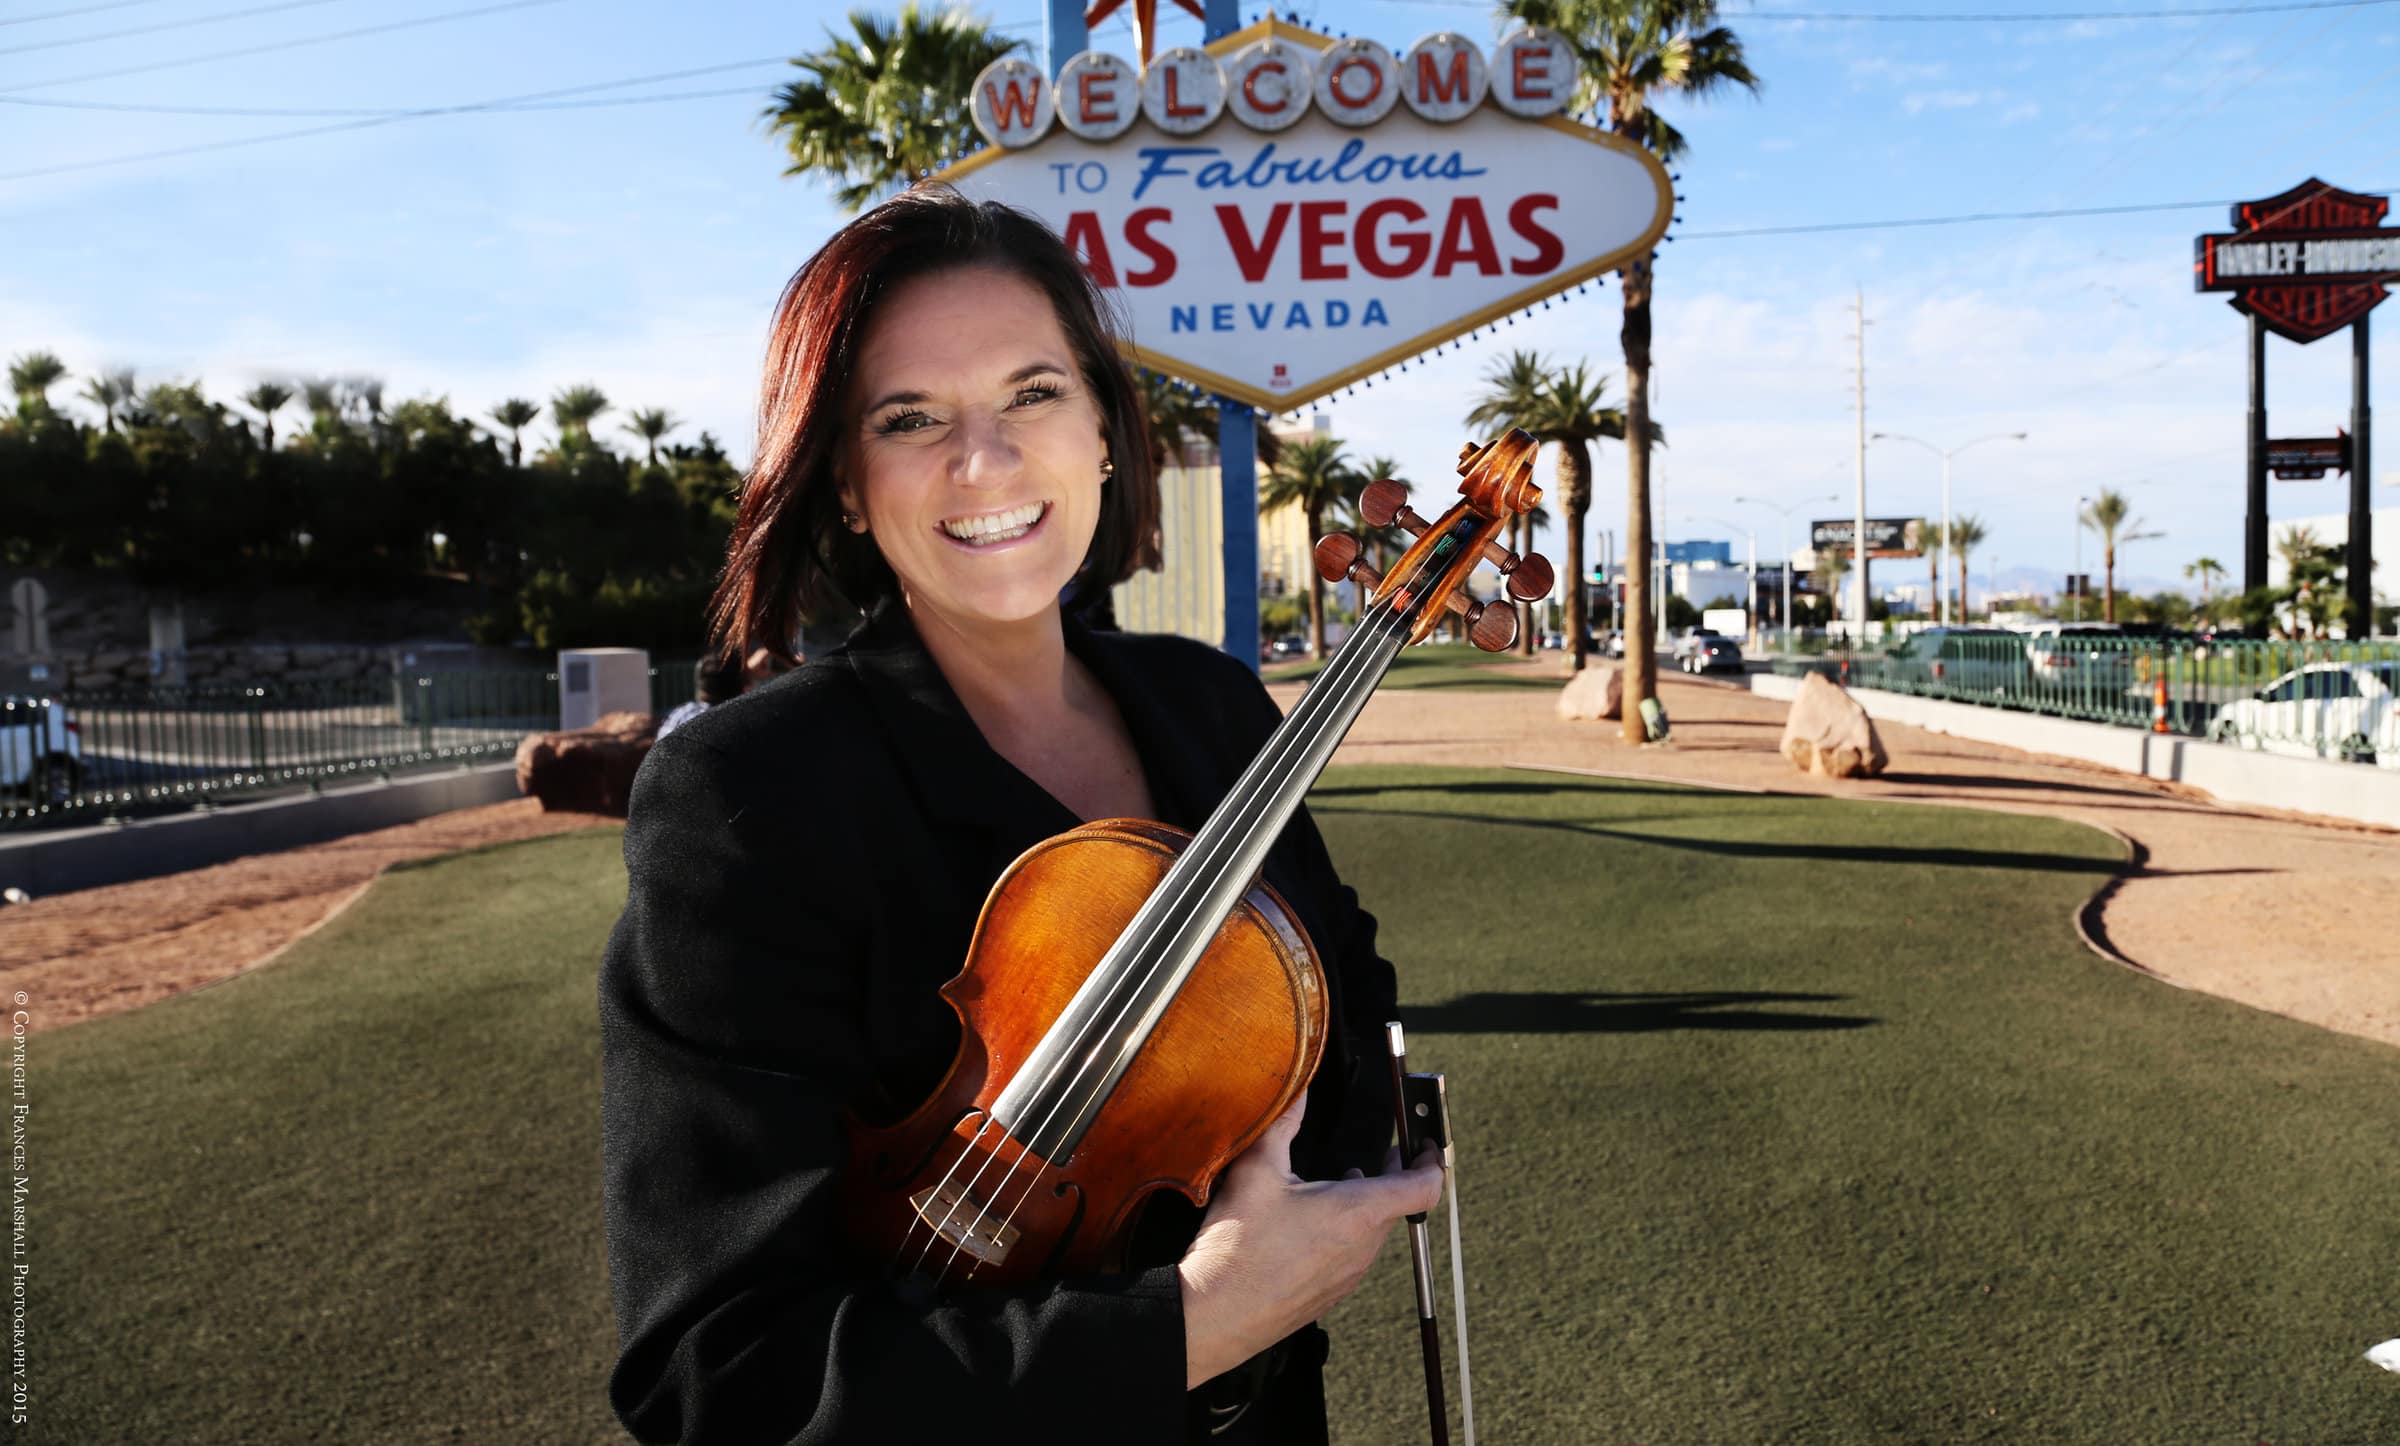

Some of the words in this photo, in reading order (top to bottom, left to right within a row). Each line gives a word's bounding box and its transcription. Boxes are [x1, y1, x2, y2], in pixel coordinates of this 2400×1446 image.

[986, 46, 1552, 132] WELCOME
[1049, 161, 1108, 195] TO
[1132, 138, 1489, 201] Fabulous
[1063, 205, 1179, 289] AS
[1216, 193, 1565, 284] VEGAS
[1169, 297, 1390, 334] NEVADA
